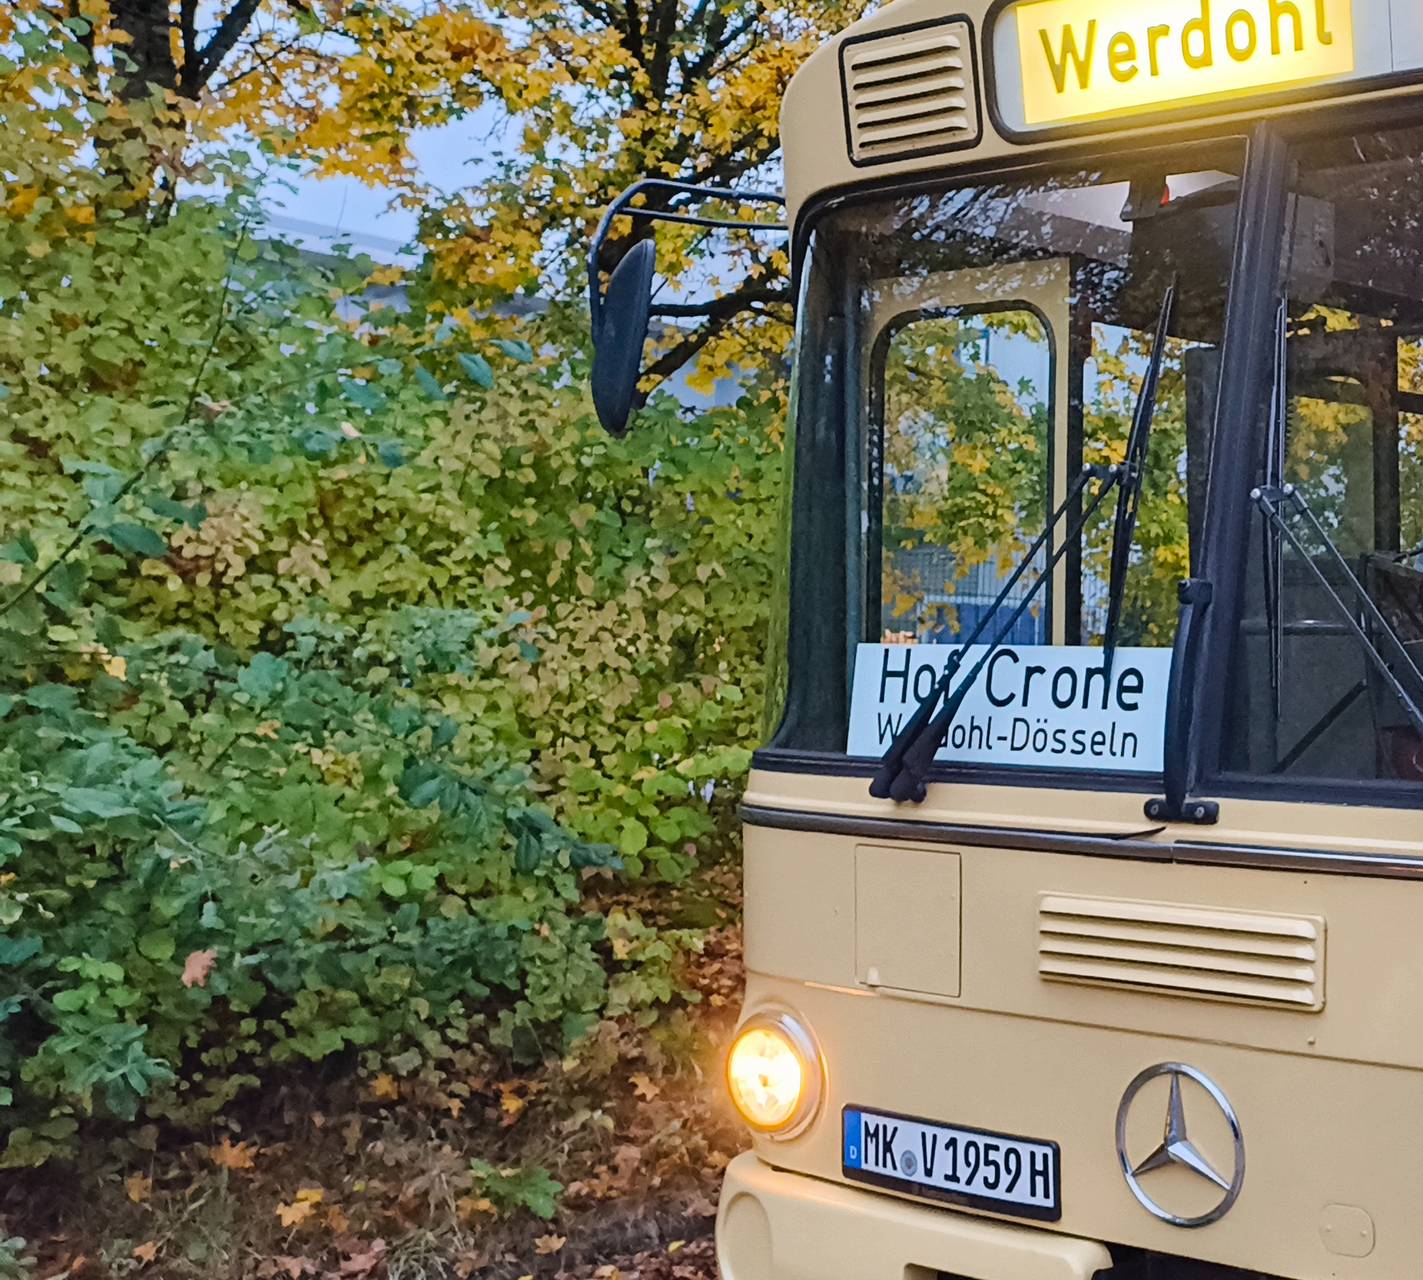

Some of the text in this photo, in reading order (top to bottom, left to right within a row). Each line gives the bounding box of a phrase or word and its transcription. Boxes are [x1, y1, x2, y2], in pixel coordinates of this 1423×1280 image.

[1038, 0, 1332, 94] Werdohl
[879, 648, 1144, 711] Hof Crone
[878, 712, 1138, 758] Wohl-Dösseln
[850, 1147, 858, 1159] D
[864, 1120, 898, 1171] MK
